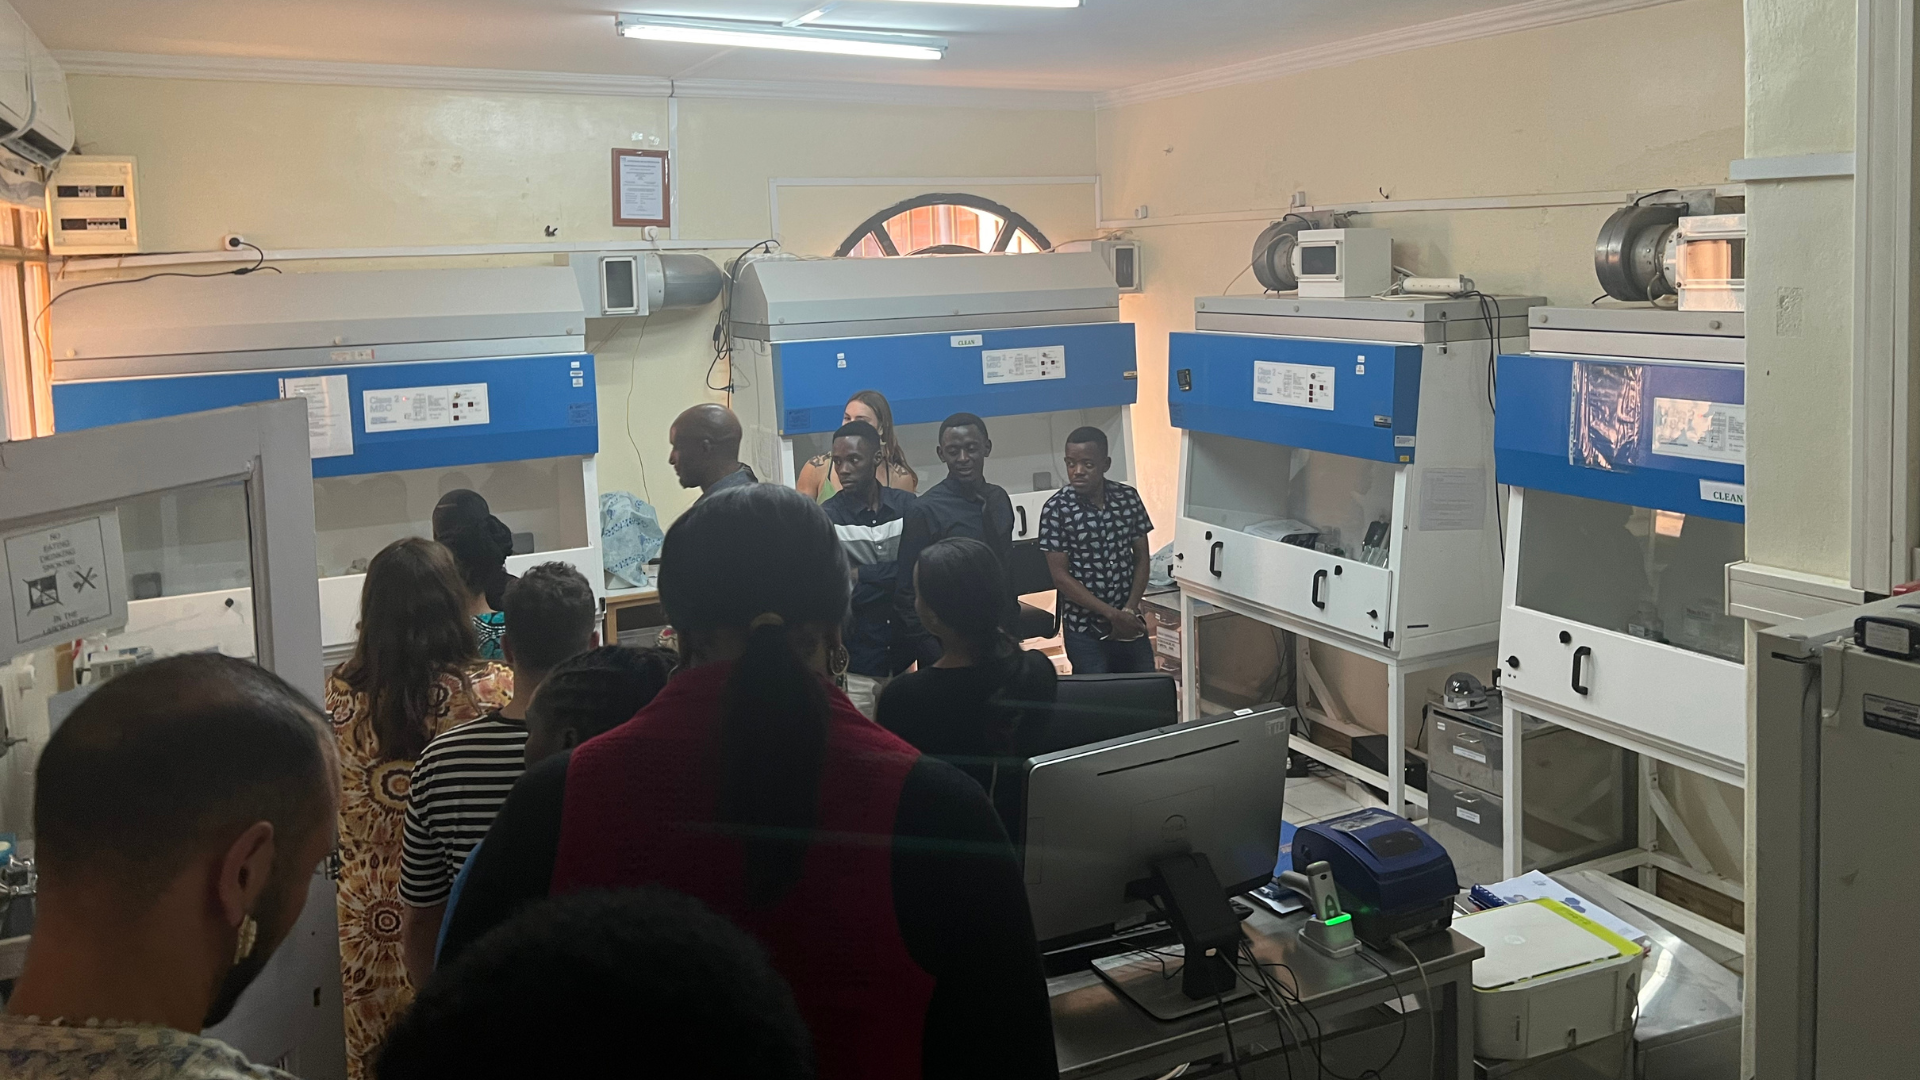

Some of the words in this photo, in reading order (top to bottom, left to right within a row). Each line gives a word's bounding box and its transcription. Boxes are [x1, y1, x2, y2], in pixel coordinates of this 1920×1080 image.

[1713, 491, 1743, 503] CLEAN
[49, 532, 61, 540] NO
[43, 539, 70, 553] EATING
[39, 547, 76, 563] DRINKING
[53, 615, 61, 623] IN
[64, 610, 77, 620] THE
[42, 616, 89, 635] LABORATORY
